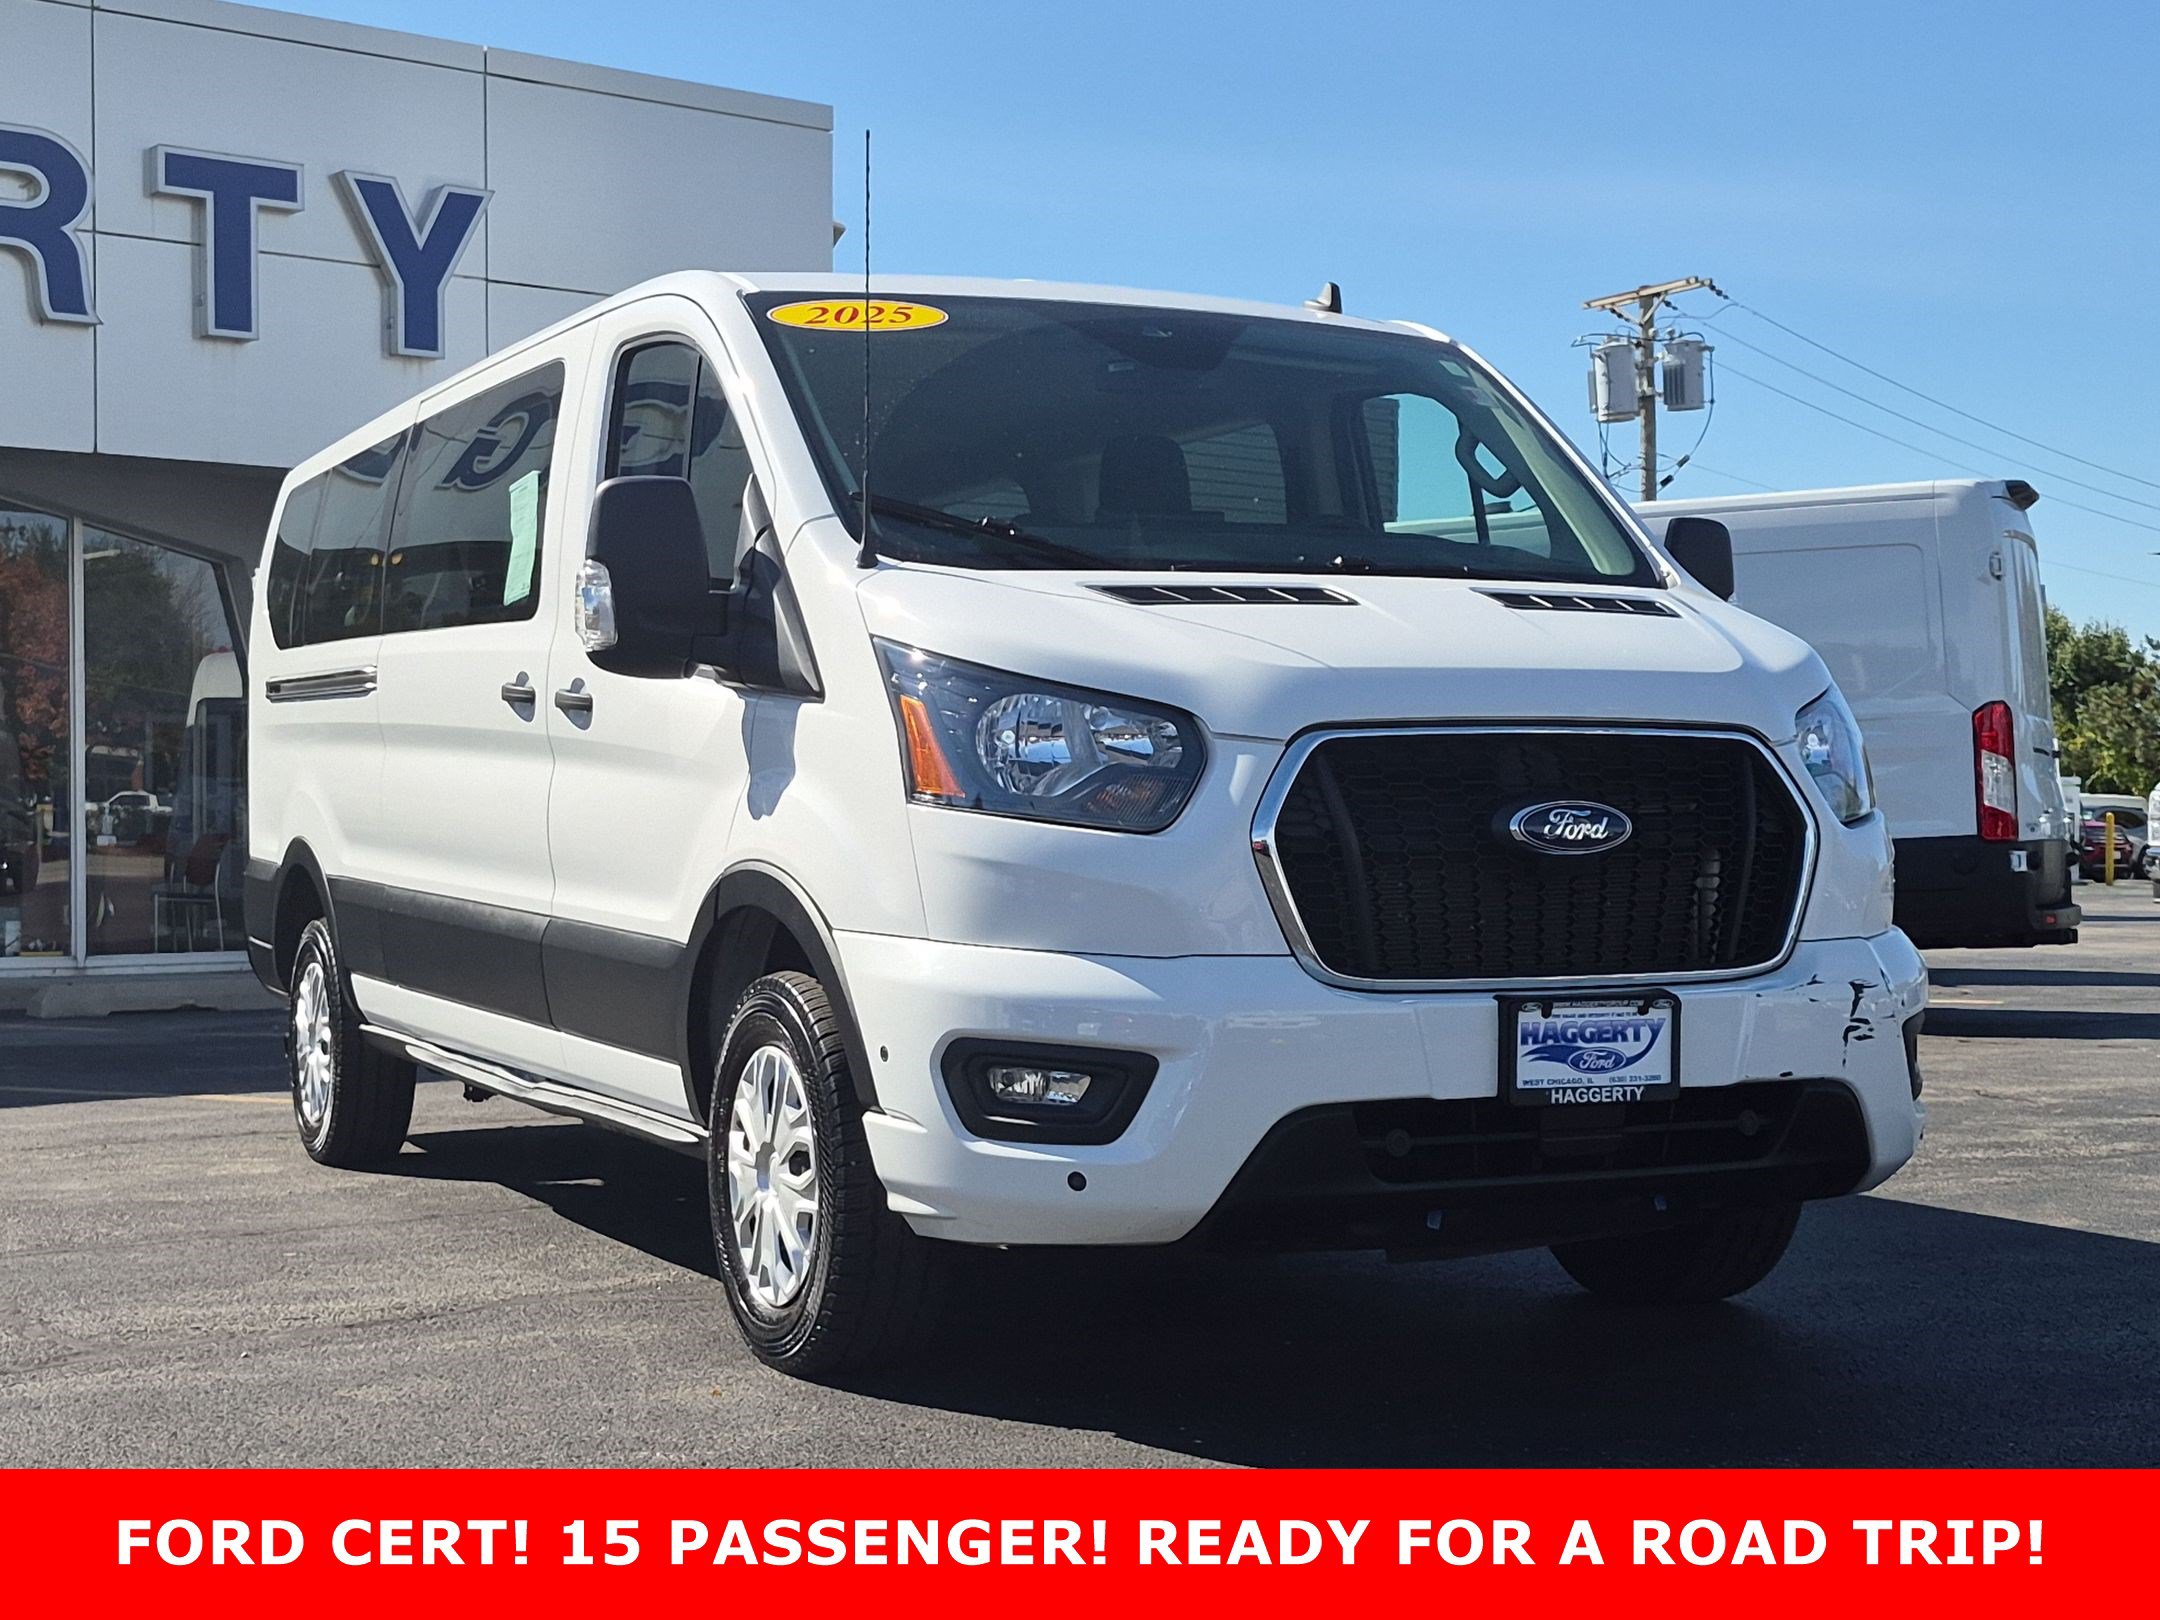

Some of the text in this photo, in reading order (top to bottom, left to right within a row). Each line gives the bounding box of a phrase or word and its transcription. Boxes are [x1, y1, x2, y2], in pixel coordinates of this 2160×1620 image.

[804, 306, 913, 324] 2025
[1543, 808, 1609, 841] Ford
[1520, 1017, 1667, 1047] HAGGERTY
[1579, 1051, 1616, 1070] Ford
[1551, 1086, 1645, 1104] HAGGERTY
